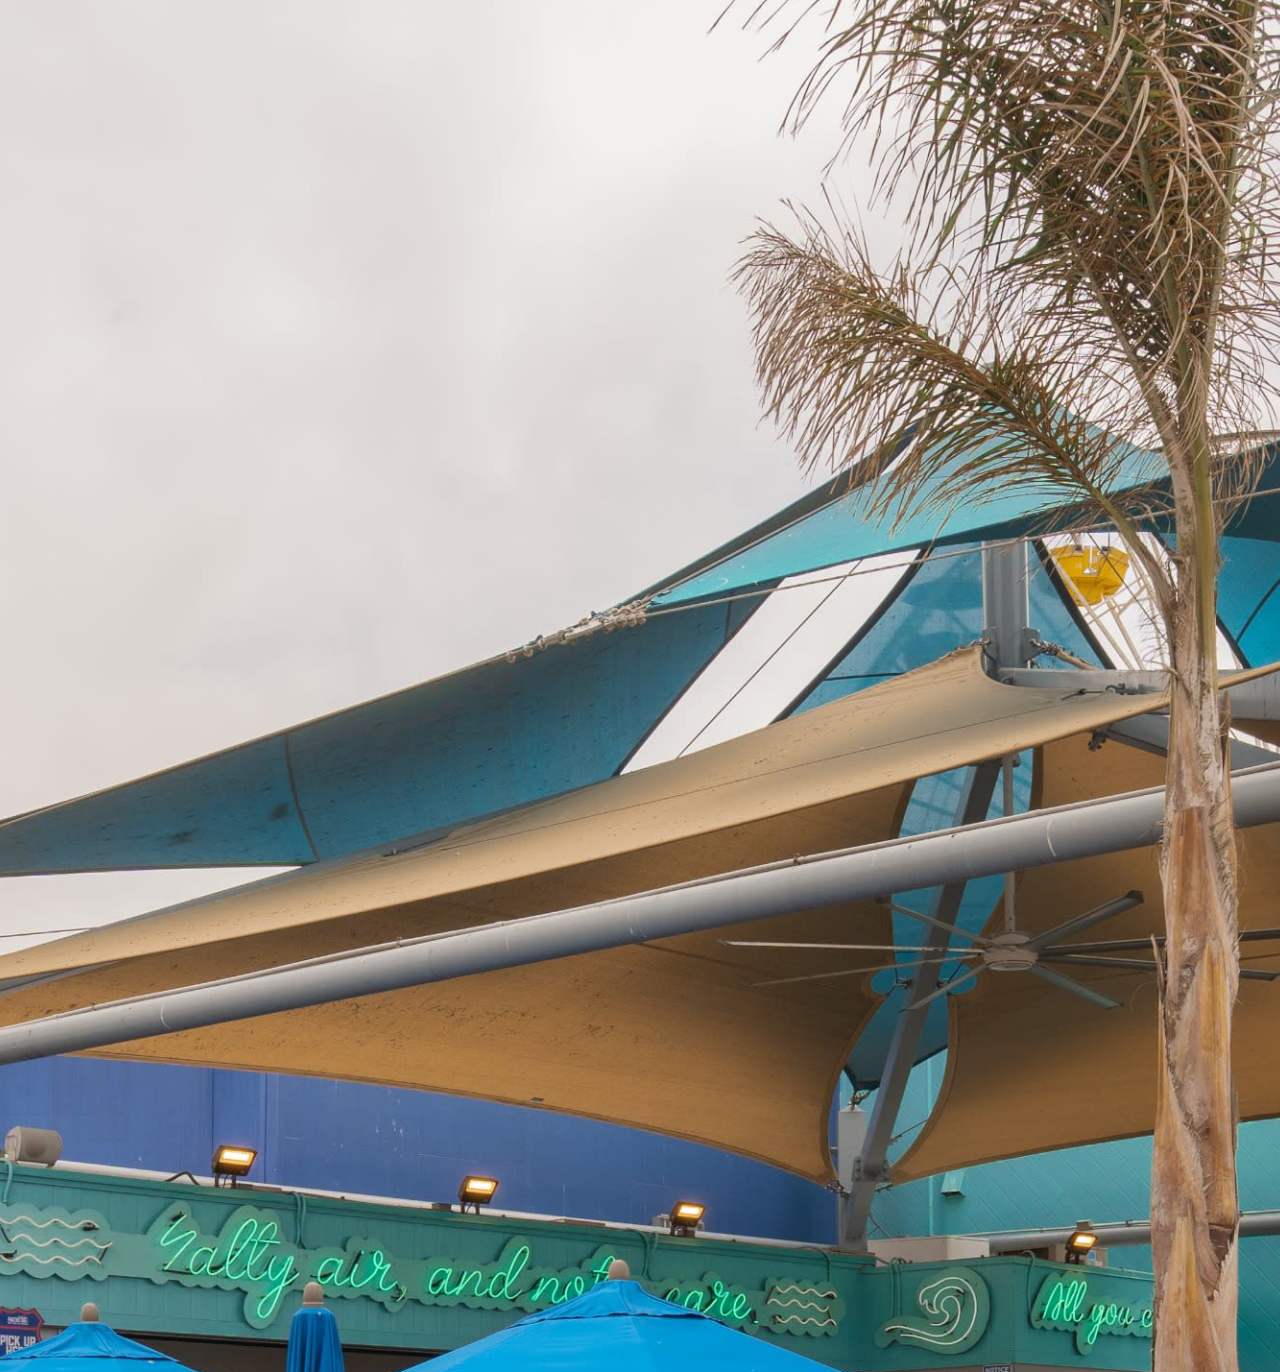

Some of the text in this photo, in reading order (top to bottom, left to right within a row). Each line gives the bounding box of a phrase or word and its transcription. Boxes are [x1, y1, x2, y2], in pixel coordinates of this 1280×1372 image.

[159, 1213, 300, 1319] Salty
[316, 1250, 408, 1302] air,
[427, 1246, 530, 1300] and
[0, 1335, 36, 1347] PICK UP
[1043, 1280, 1087, 1322] All
[1088, 1304, 1134, 1344] you
